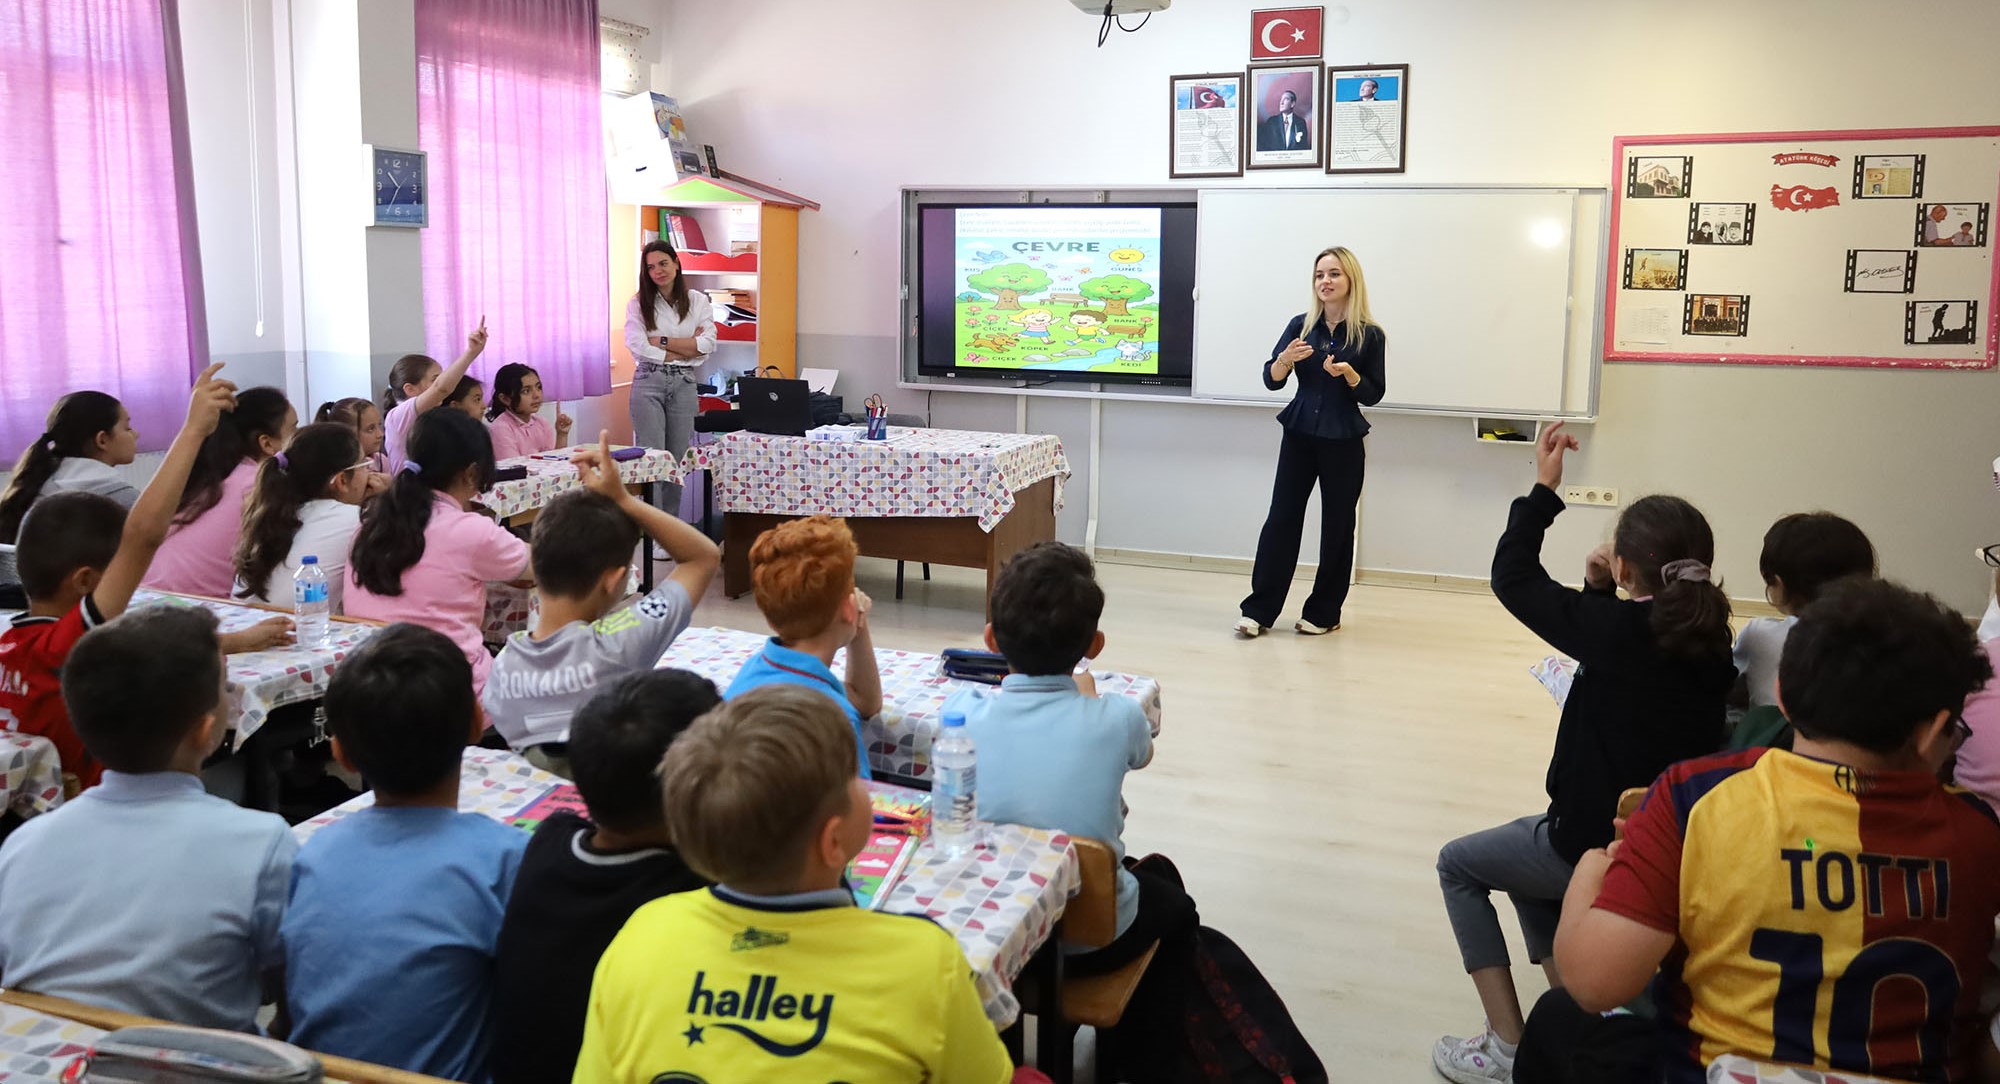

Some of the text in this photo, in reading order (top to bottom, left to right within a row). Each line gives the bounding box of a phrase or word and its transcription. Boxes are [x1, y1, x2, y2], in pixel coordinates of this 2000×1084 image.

[395, 207, 400, 215] 6
[1012, 241, 1101, 254] ÇEVRE
[499, 661, 598, 699] RONALDO
[1780, 848, 1950, 919] TOTTI
[687, 971, 835, 1058] halley
[1749, 927, 1962, 1078] 10
